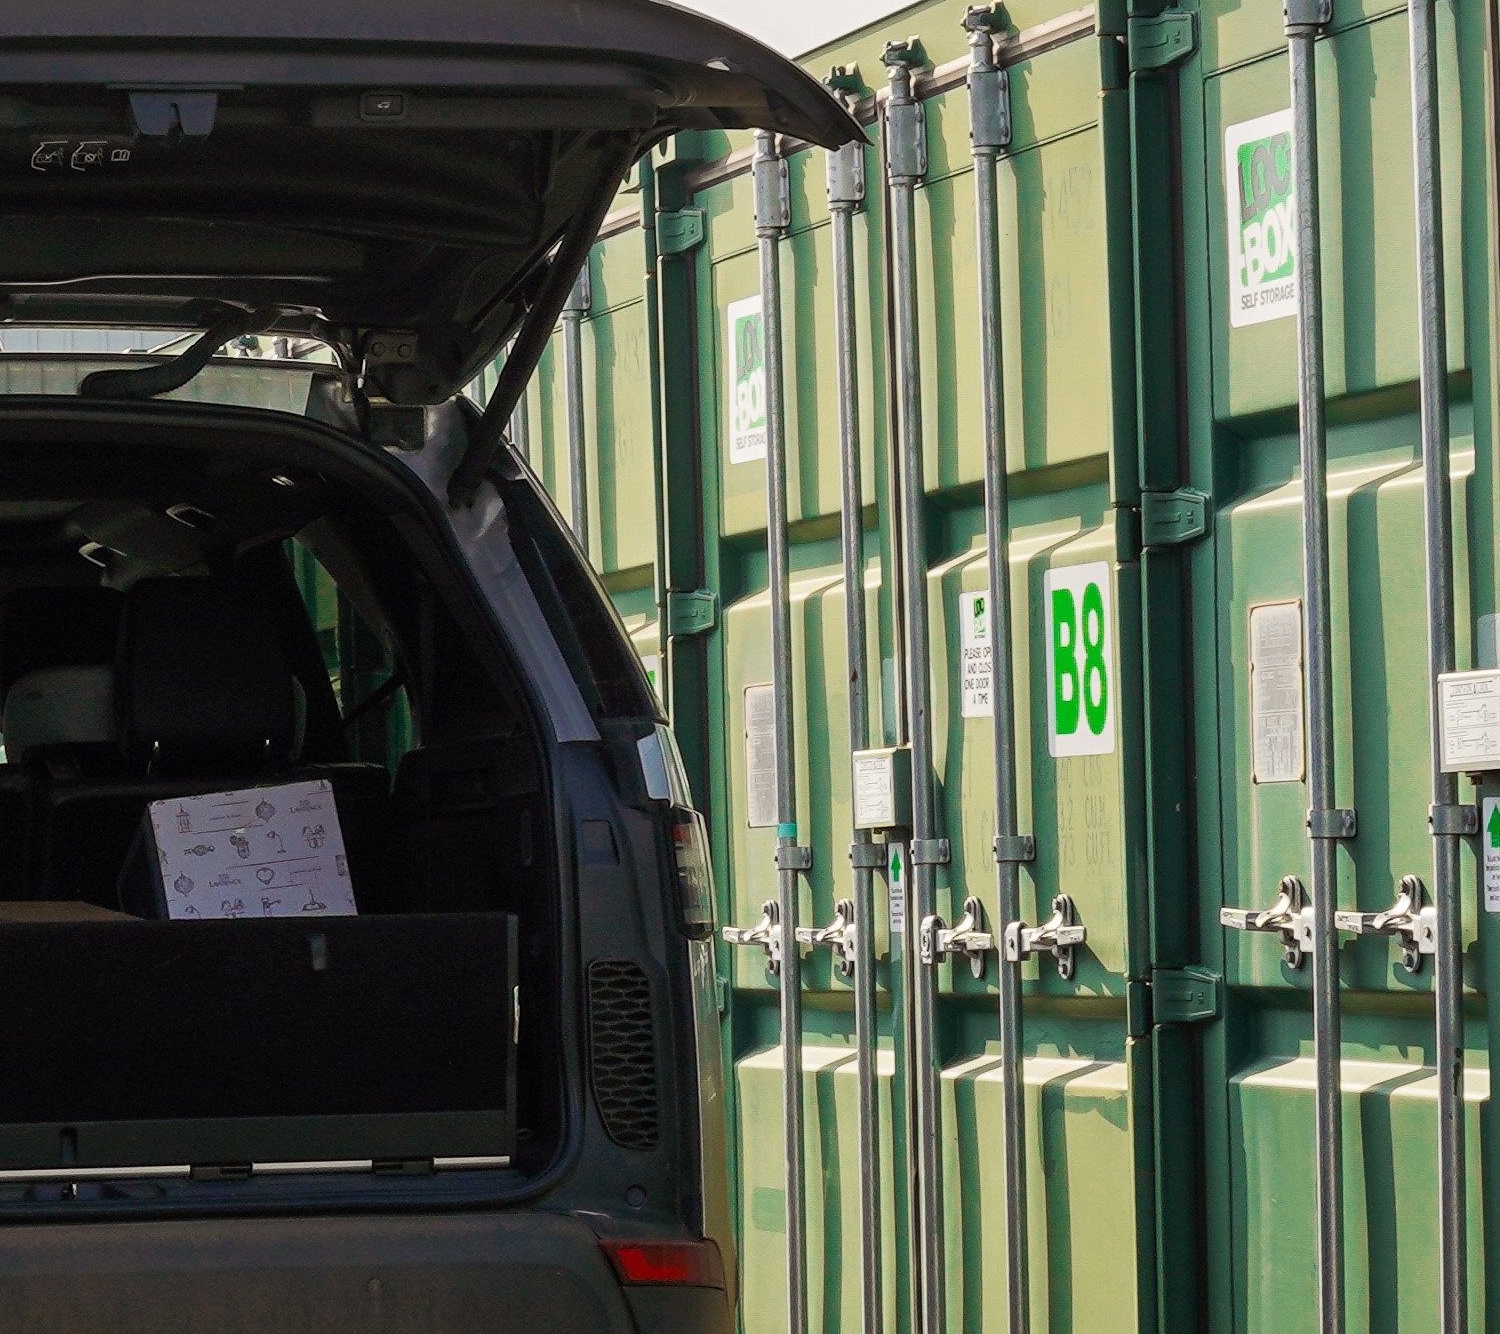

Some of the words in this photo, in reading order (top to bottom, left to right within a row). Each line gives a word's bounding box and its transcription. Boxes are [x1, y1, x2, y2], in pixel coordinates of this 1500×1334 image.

[1241, 292, 1258, 310] SELF
[1260, 283, 1295, 306] STORAGE
[978, 662, 992, 674] CLOS
[1052, 582, 1108, 735] B8
